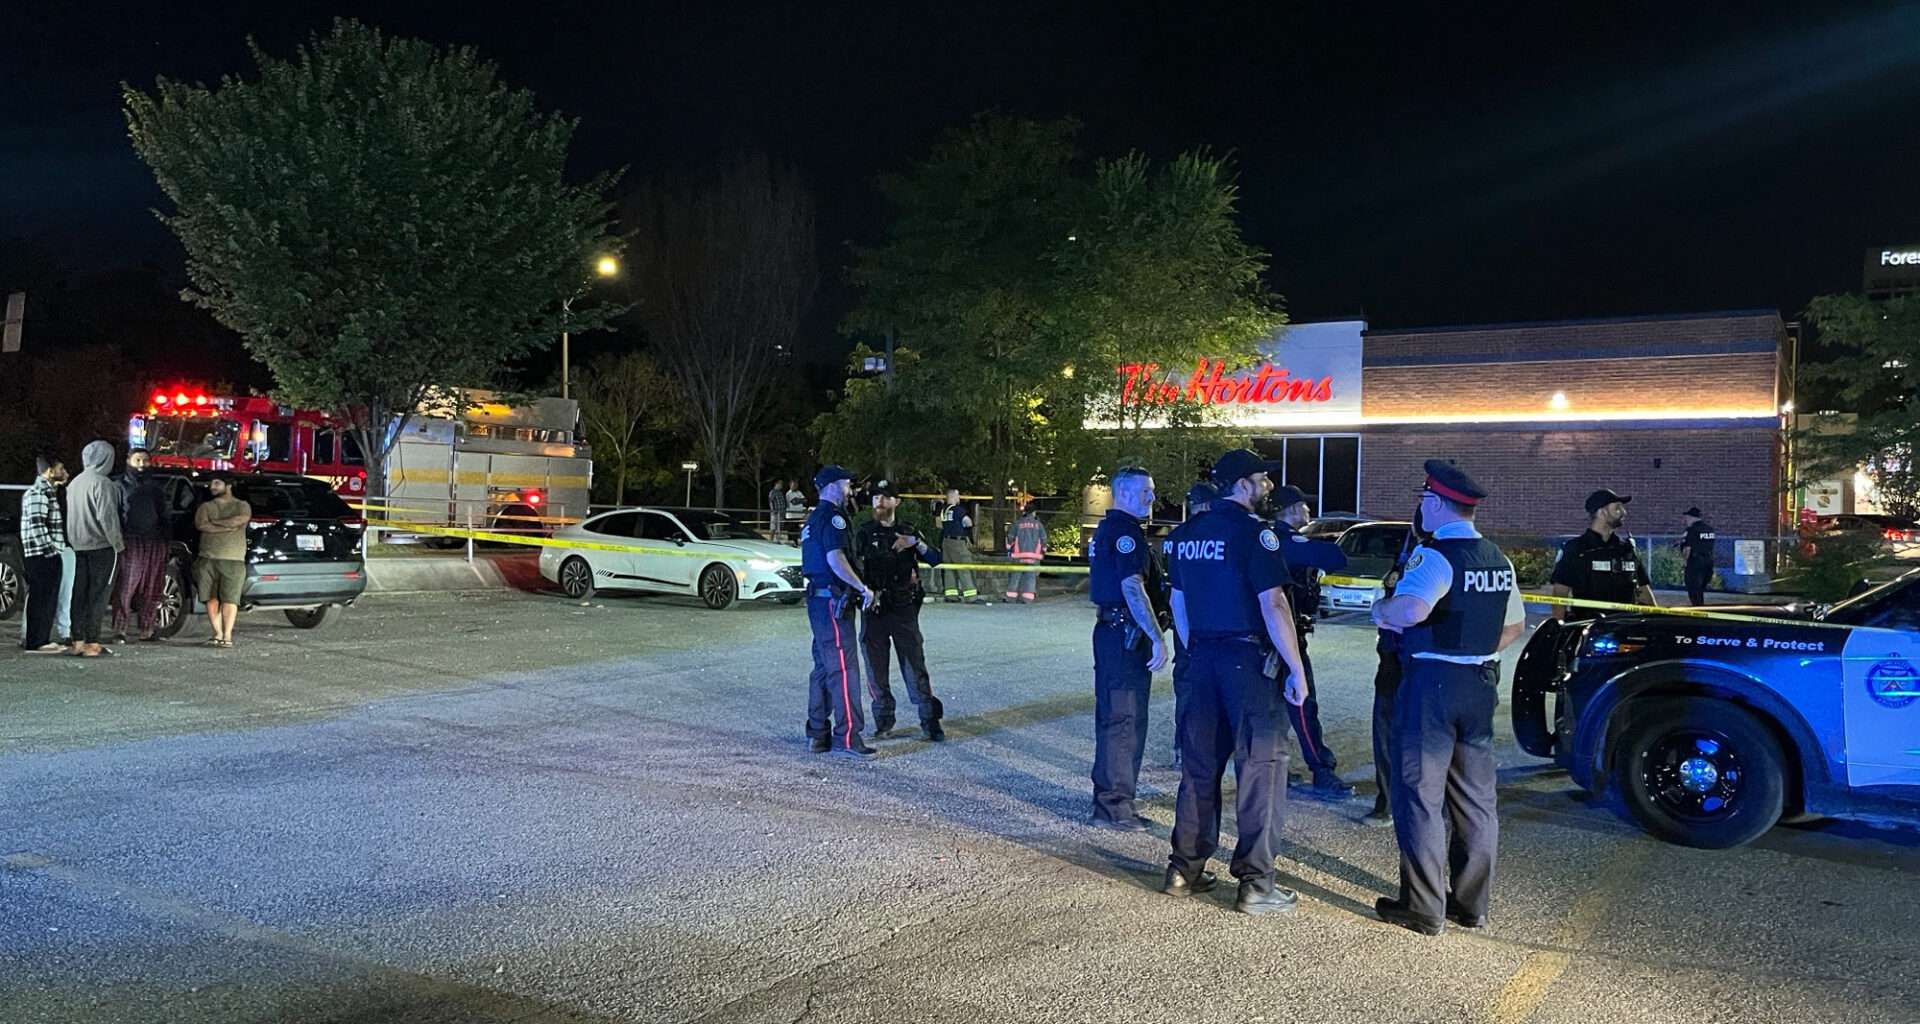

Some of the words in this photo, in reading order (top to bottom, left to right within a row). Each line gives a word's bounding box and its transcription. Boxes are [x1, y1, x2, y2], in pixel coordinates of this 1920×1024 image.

[1186, 357, 1333, 405] Hortons
[1177, 540, 1225, 560] POLICE
[1463, 570, 1512, 592] POLICE
[1674, 635, 1693, 644] To
[1696, 635, 1742, 647] Serve
[1745, 637, 1758, 648] &
[1763, 637, 1825, 652] Protect
